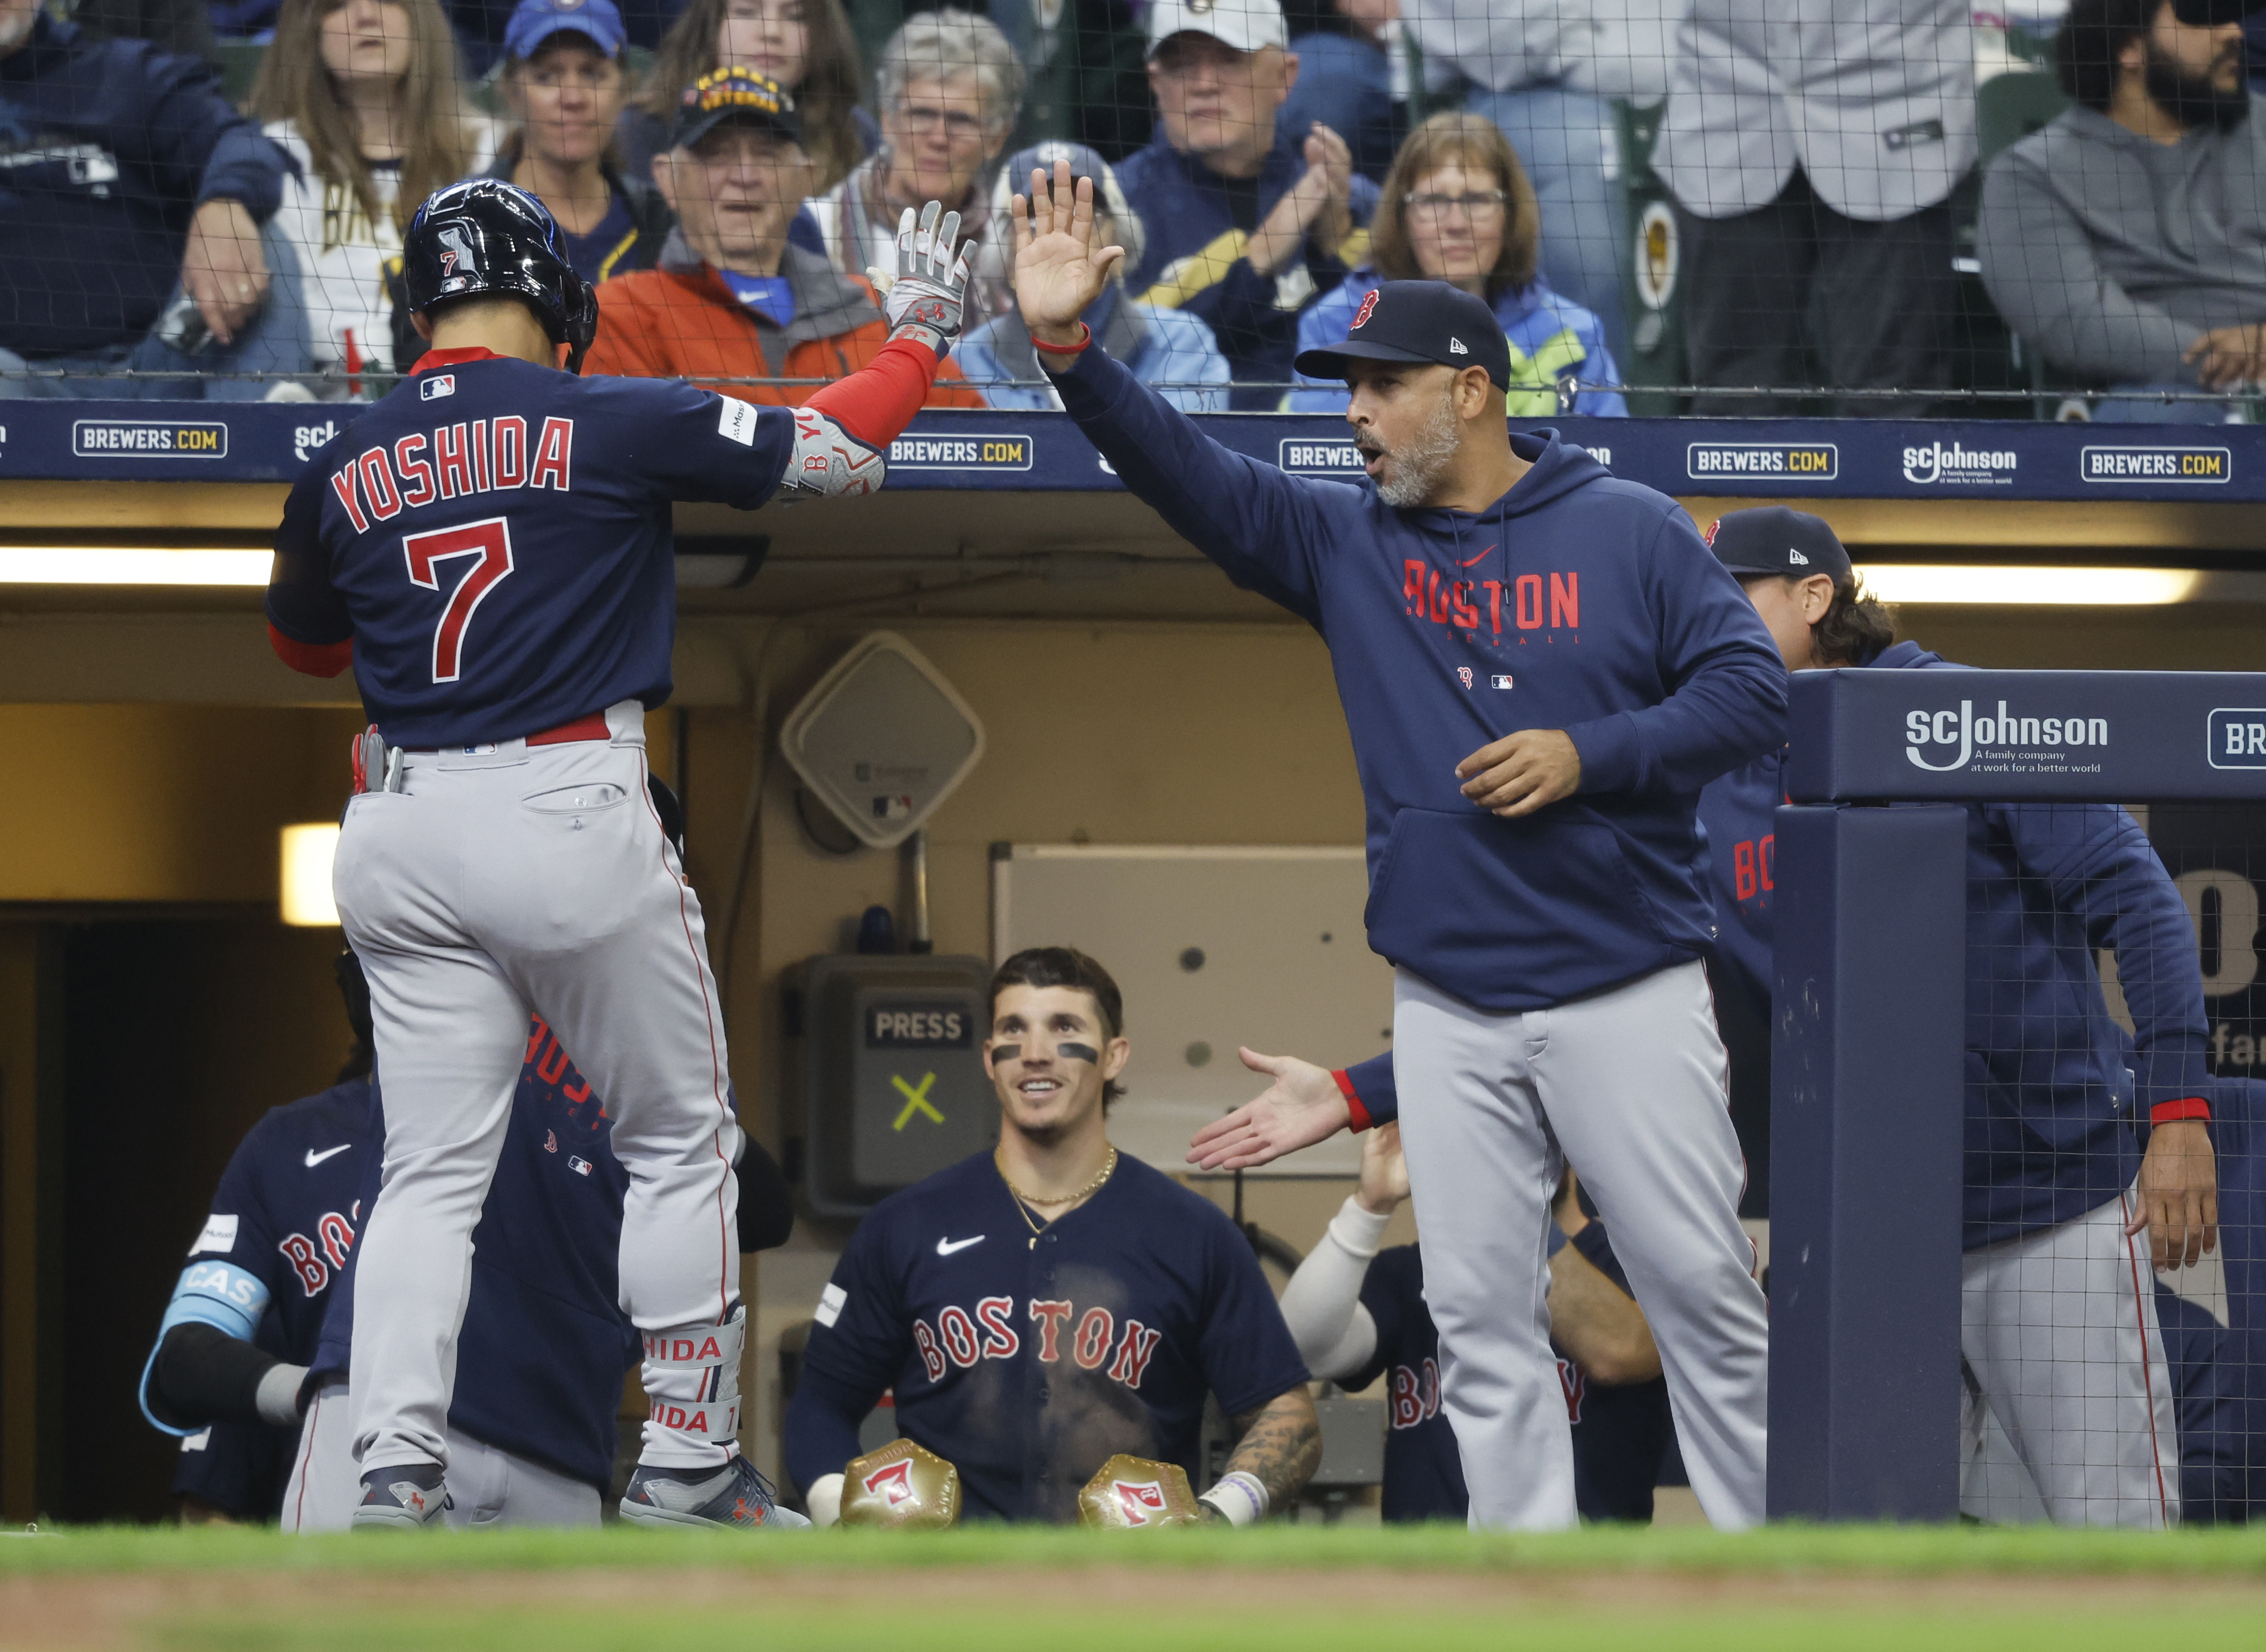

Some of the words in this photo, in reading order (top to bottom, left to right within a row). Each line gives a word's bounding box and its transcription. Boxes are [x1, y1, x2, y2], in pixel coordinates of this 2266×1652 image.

[440, 250, 458, 277] 7
[83, 428, 217, 450] BREWERS.COM
[891, 441, 1023, 462] BREWERS.COM
[1698, 451, 1828, 471] BREWERS.COM
[331, 415, 574, 534] YOSHIDA
[2091, 454, 2221, 474] BREWERS.COM
[403, 517, 514, 684] 7
[2226, 723, 2266, 754] BR
[1971, 764, 1981, 772] at
[1983, 763, 2009, 772] work
[2012, 763, 2026, 772] for
[2038, 763, 2068, 773] better
[2072, 764, 2101, 773] world
[1975, 750, 1983, 759] A
[1984, 750, 2016, 761] family
[2018, 752, 2065, 762] company
[876, 1012, 962, 1040] PRESS
[914, 1295, 1162, 1389] BOSTON
